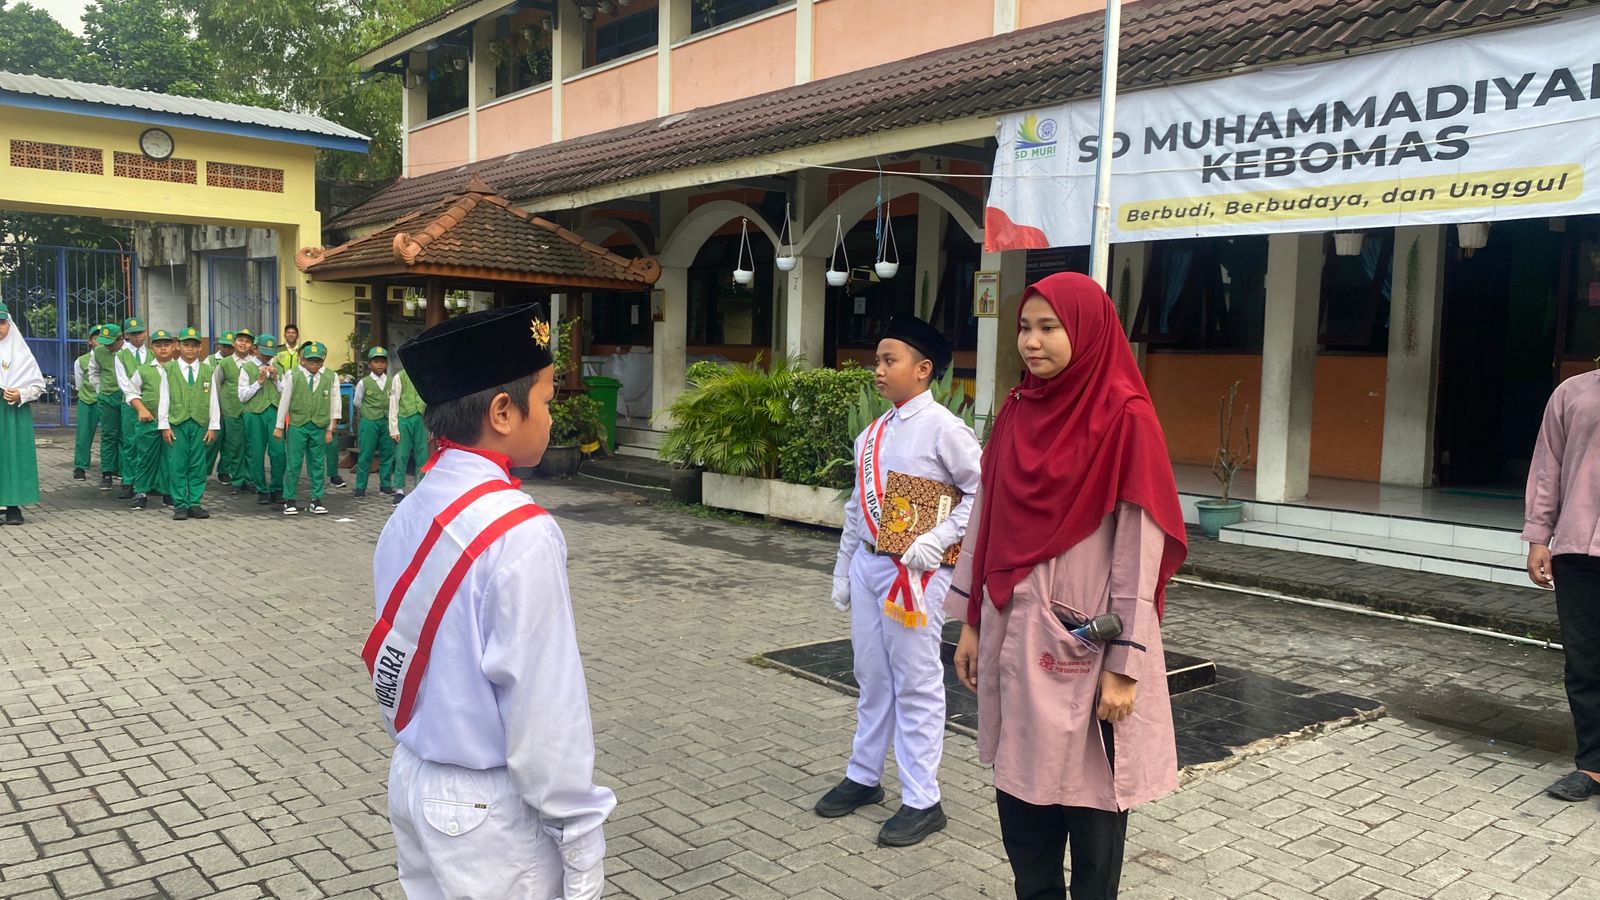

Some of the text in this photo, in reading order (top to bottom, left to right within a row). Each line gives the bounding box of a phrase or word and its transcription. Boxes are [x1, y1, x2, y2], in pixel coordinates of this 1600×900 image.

[1143, 63, 1600, 155] MUHAMMADIYA
[1014, 145, 1056, 160] SD MURI
[1201, 125, 1470, 184] KEBOMAS
[1126, 173, 1568, 223] Berbudi, Berbudaya, dan Unggul
[864, 438, 875, 485] PETUGAS
[375, 645, 406, 709] UPACARA
